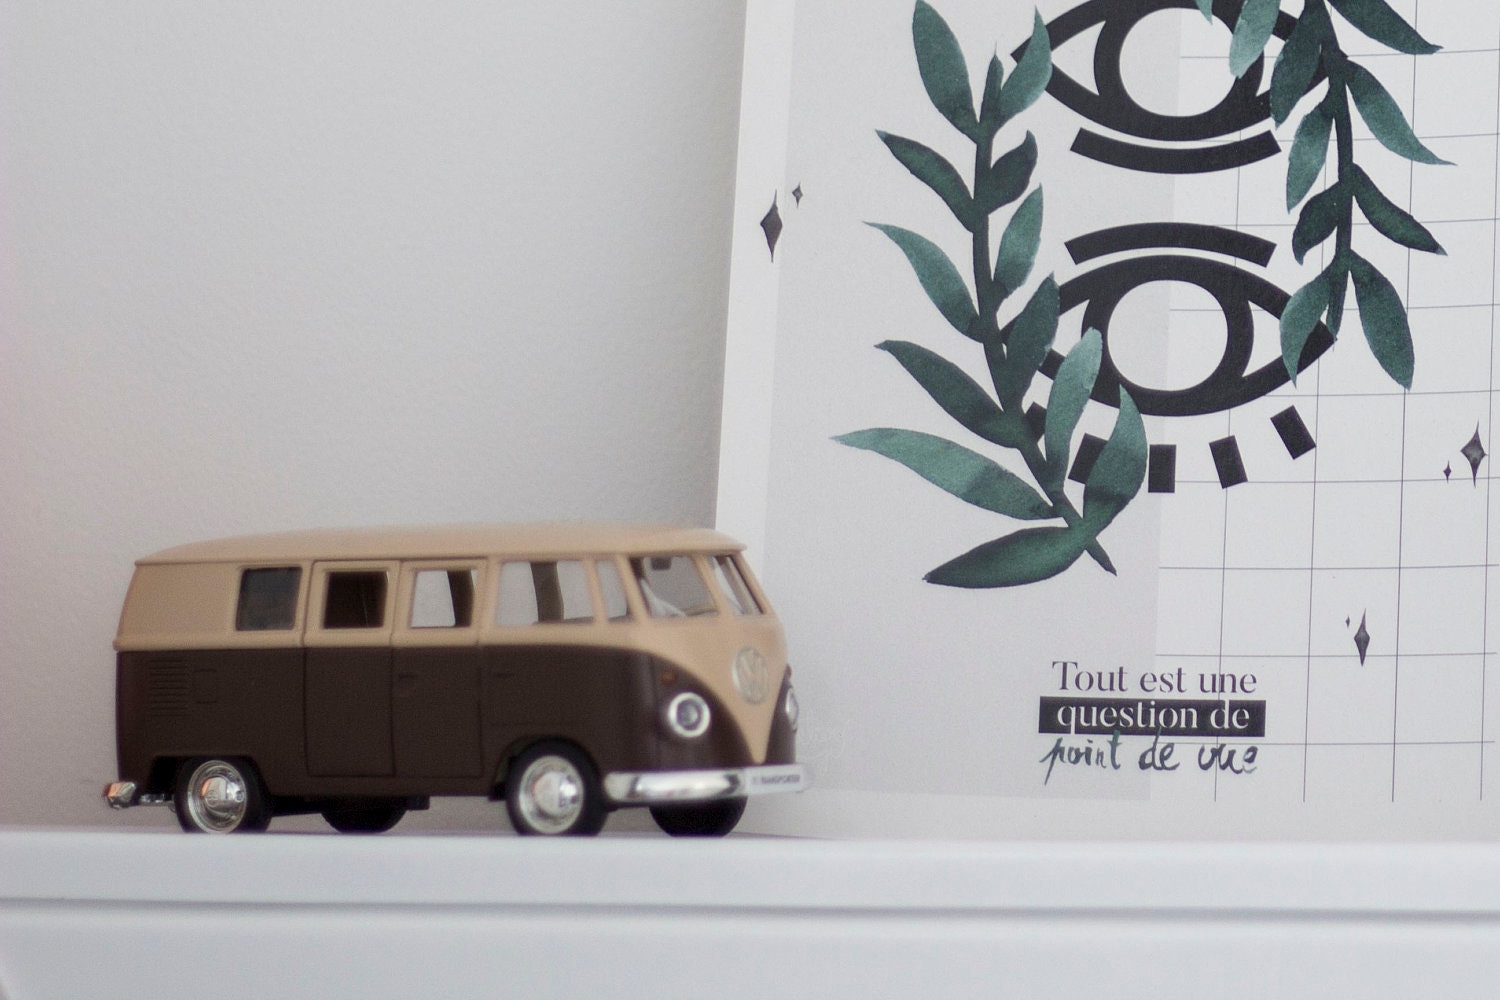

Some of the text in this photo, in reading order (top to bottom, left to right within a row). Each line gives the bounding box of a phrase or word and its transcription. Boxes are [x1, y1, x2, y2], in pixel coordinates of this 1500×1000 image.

[1052, 660, 1258, 694] Tout est une
[1056, 700, 1250, 734] question de
[1038, 726, 1259, 786] point de vue
